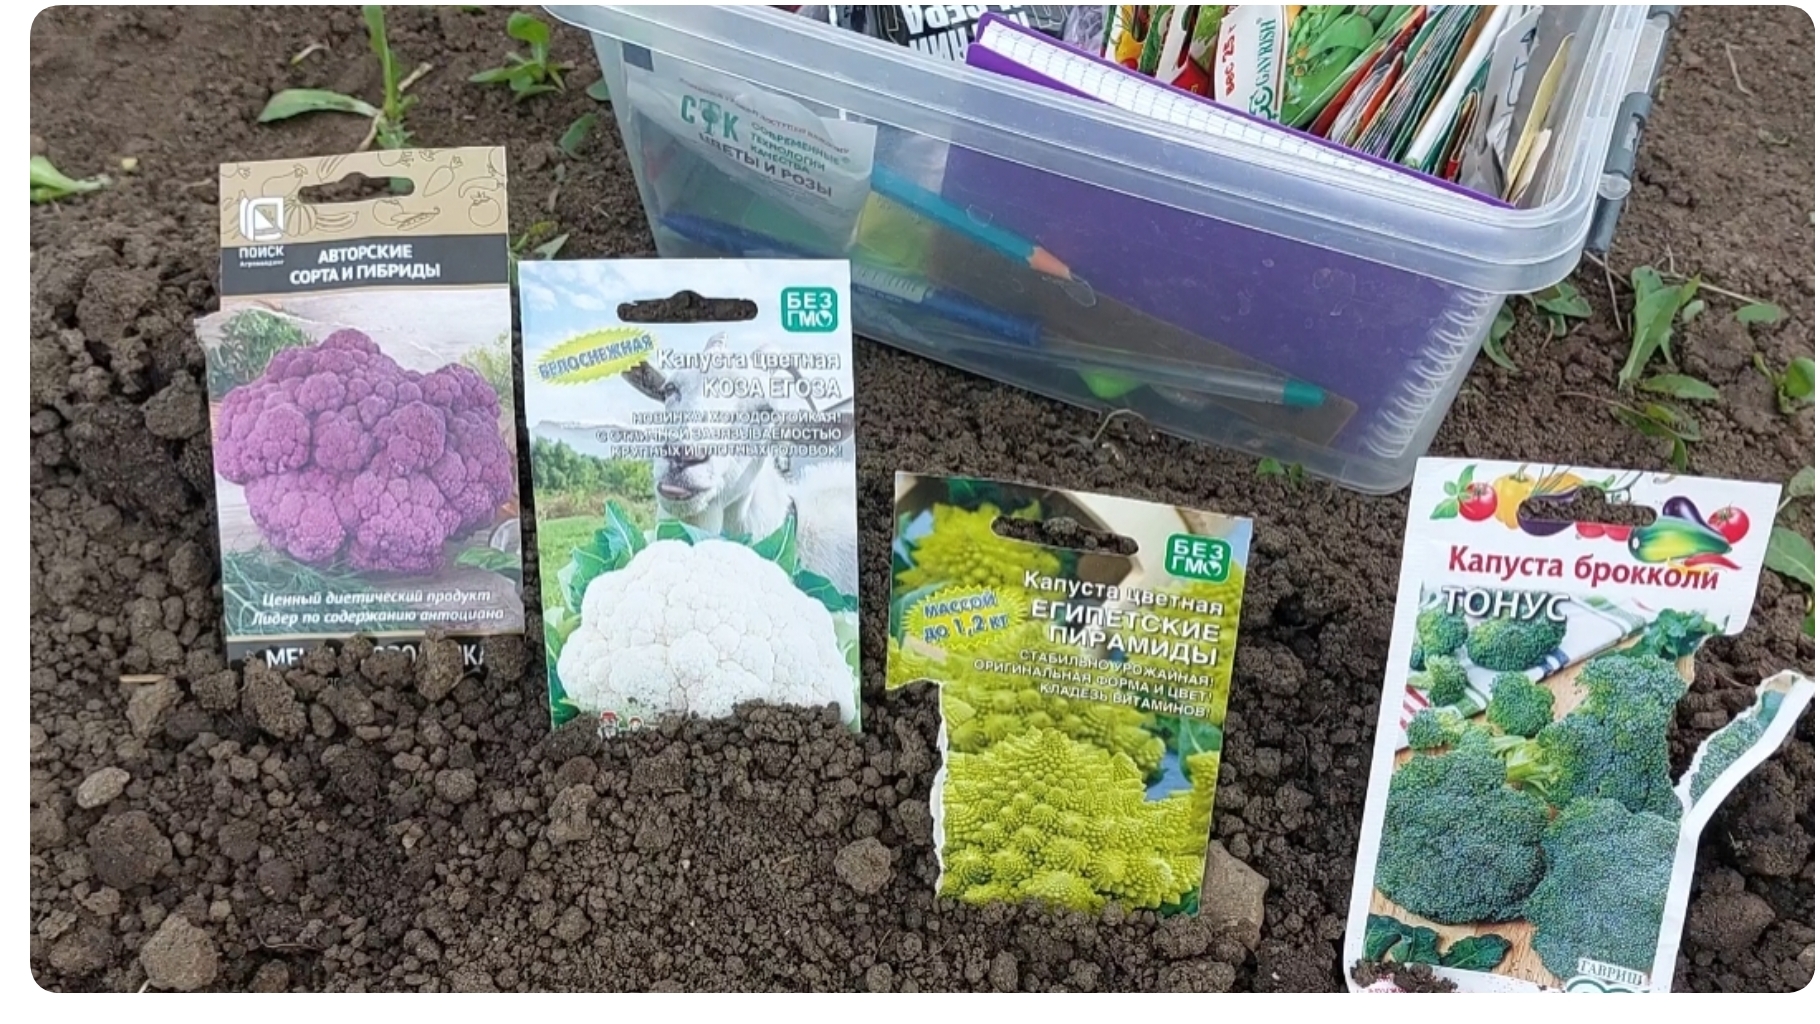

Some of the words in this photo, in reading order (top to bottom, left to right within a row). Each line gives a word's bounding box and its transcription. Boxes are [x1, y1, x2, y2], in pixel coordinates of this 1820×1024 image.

[1222, 34, 1236, 62] 25
[1255, 18, 1277, 88] GAVRISH
[750, 122, 841, 165] СОВРЕМЕННЫЕ
[750, 132, 826, 172] ТЕХНОЛОГИИ
[750, 145, 810, 174] КАЧЕСТВА
[763, 162, 776, 175] И
[781, 169, 832, 197] РОЗЫ
[239, 245, 285, 259] ПОИСК
[318, 244, 413, 264] АВТОРСКИЕ
[289, 268, 340, 285] СОРТА
[341, 266, 353, 280] И
[356, 263, 441, 280] ГИБРИДЫ
[786, 291, 833, 308] БЕЗ
[786, 310, 833, 327] ГМО
[538, 334, 653, 381] БЕЛОСНЕЖНАЯ
[656, 350, 748, 373] Капуста
[752, 352, 842, 372] цветная
[702, 377, 765, 399] КОЗА
[769, 377, 842, 399] ЕГОЗА
[708, 411, 842, 425] ХОЛОДОСТОЙКАЯ!
[691, 427, 842, 441] ЗАВЯЗЫВАЕМОСТЬЮ
[684, 445, 696, 457] И
[698, 444, 768, 457] ПЛОТНЫХ
[769, 444, 843, 457] ГОЛОВОК!
[1173, 540, 1224, 559] БЕЗ
[1171, 556, 1223, 576] ГМО
[1448, 545, 1563, 579] Капуста
[1573, 552, 1719, 590] брокколи
[262, 590, 322, 607] Ценный
[325, 589, 423, 605] диетический
[426, 589, 491, 605] продукт
[923, 590, 997, 618] МАССОЙ
[1023, 570, 1122, 600] Капуста
[1125, 586, 1225, 616] цветная
[1441, 585, 1570, 622] ТОНУС
[251, 611, 299, 626] Лидер
[302, 612, 320, 624] по
[324, 611, 417, 625] содержанию
[420, 609, 504, 622] антоциана
[953, 614, 986, 638] 1,2
[1031, 599, 1221, 643] ЕГИПЕТСКИЕ
[1048, 625, 1218, 666] ПИРАМИДЫ
[1019, 649, 1116, 671] СТАБИЛЬНО
[973, 659, 1092, 685] ОРИГИНАЛЬНАЯ
[1096, 676, 1149, 693] ФОРМА
[1153, 683, 1165, 695] И
[1167, 684, 1214, 703] ЦВЕТ!
[1039, 682, 1108, 702] КЛАДЕЗЬ
[1112, 691, 1211, 718] ВИТАМИНОВ!
[1579, 960, 1643, 987] ГАВРИШ
